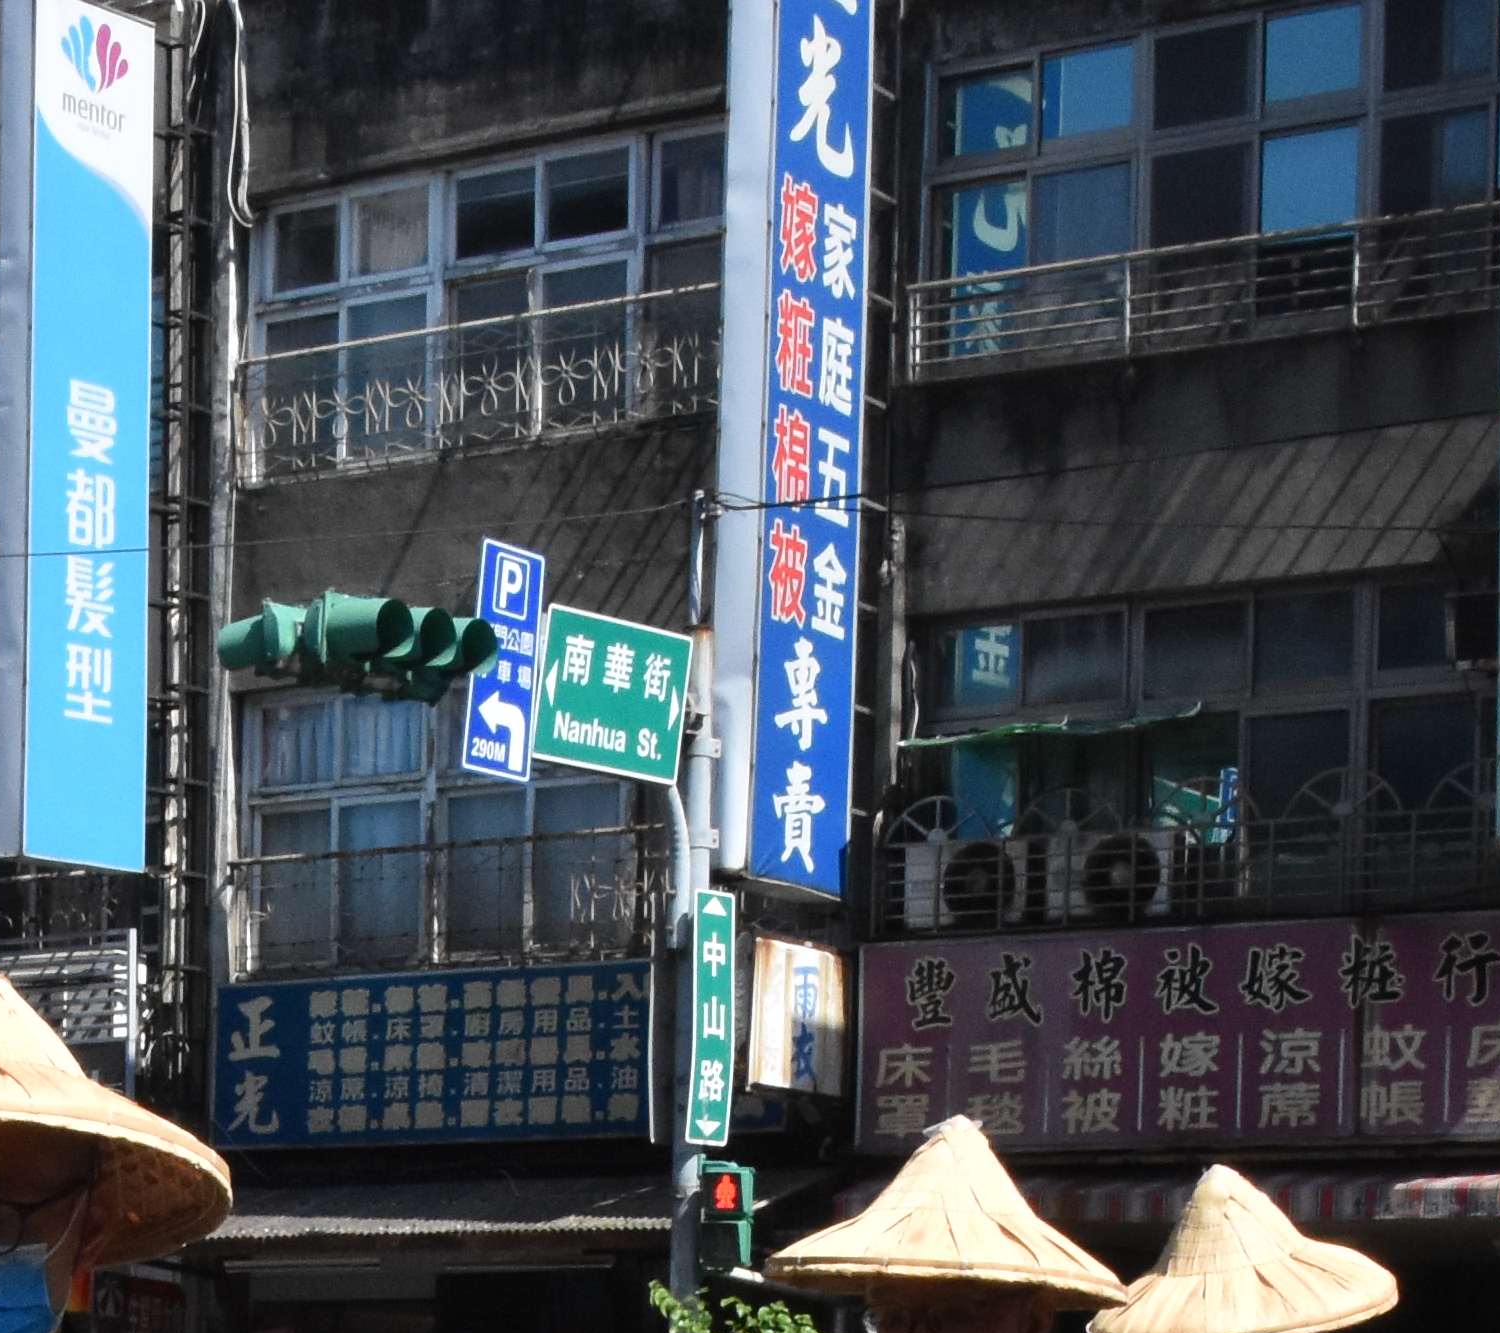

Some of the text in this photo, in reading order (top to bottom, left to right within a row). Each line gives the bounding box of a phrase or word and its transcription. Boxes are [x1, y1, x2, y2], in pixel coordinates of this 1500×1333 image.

[63, 93, 126, 132] mentor
[790, 0, 858, 178] 光
[769, 173, 818, 628] 嫁粧棉被
[811, 203, 857, 643] 家庭五金
[65, 381, 117, 726] 曼都髮型
[499, 560, 524, 609] P
[477, 660, 532, 690] 車場
[490, 623, 534, 656] 門公園
[562, 634, 672, 702] 南華街
[471, 737, 506, 763] 290M
[553, 710, 662, 761] Nanhua St.
[773, 637, 828, 873] 專賣
[228, 996, 281, 1135] 正光
[699, 932, 726, 1102] 中山路
[791, 966, 819, 1081] 雨衣
[875, 1043, 933, 1137] 床罩
[1062, 1036, 1122, 1133] 絲被
[1158, 1032, 1219, 1130] 嫁粧
[1360, 1023, 1427, 1125] 蚊帳
